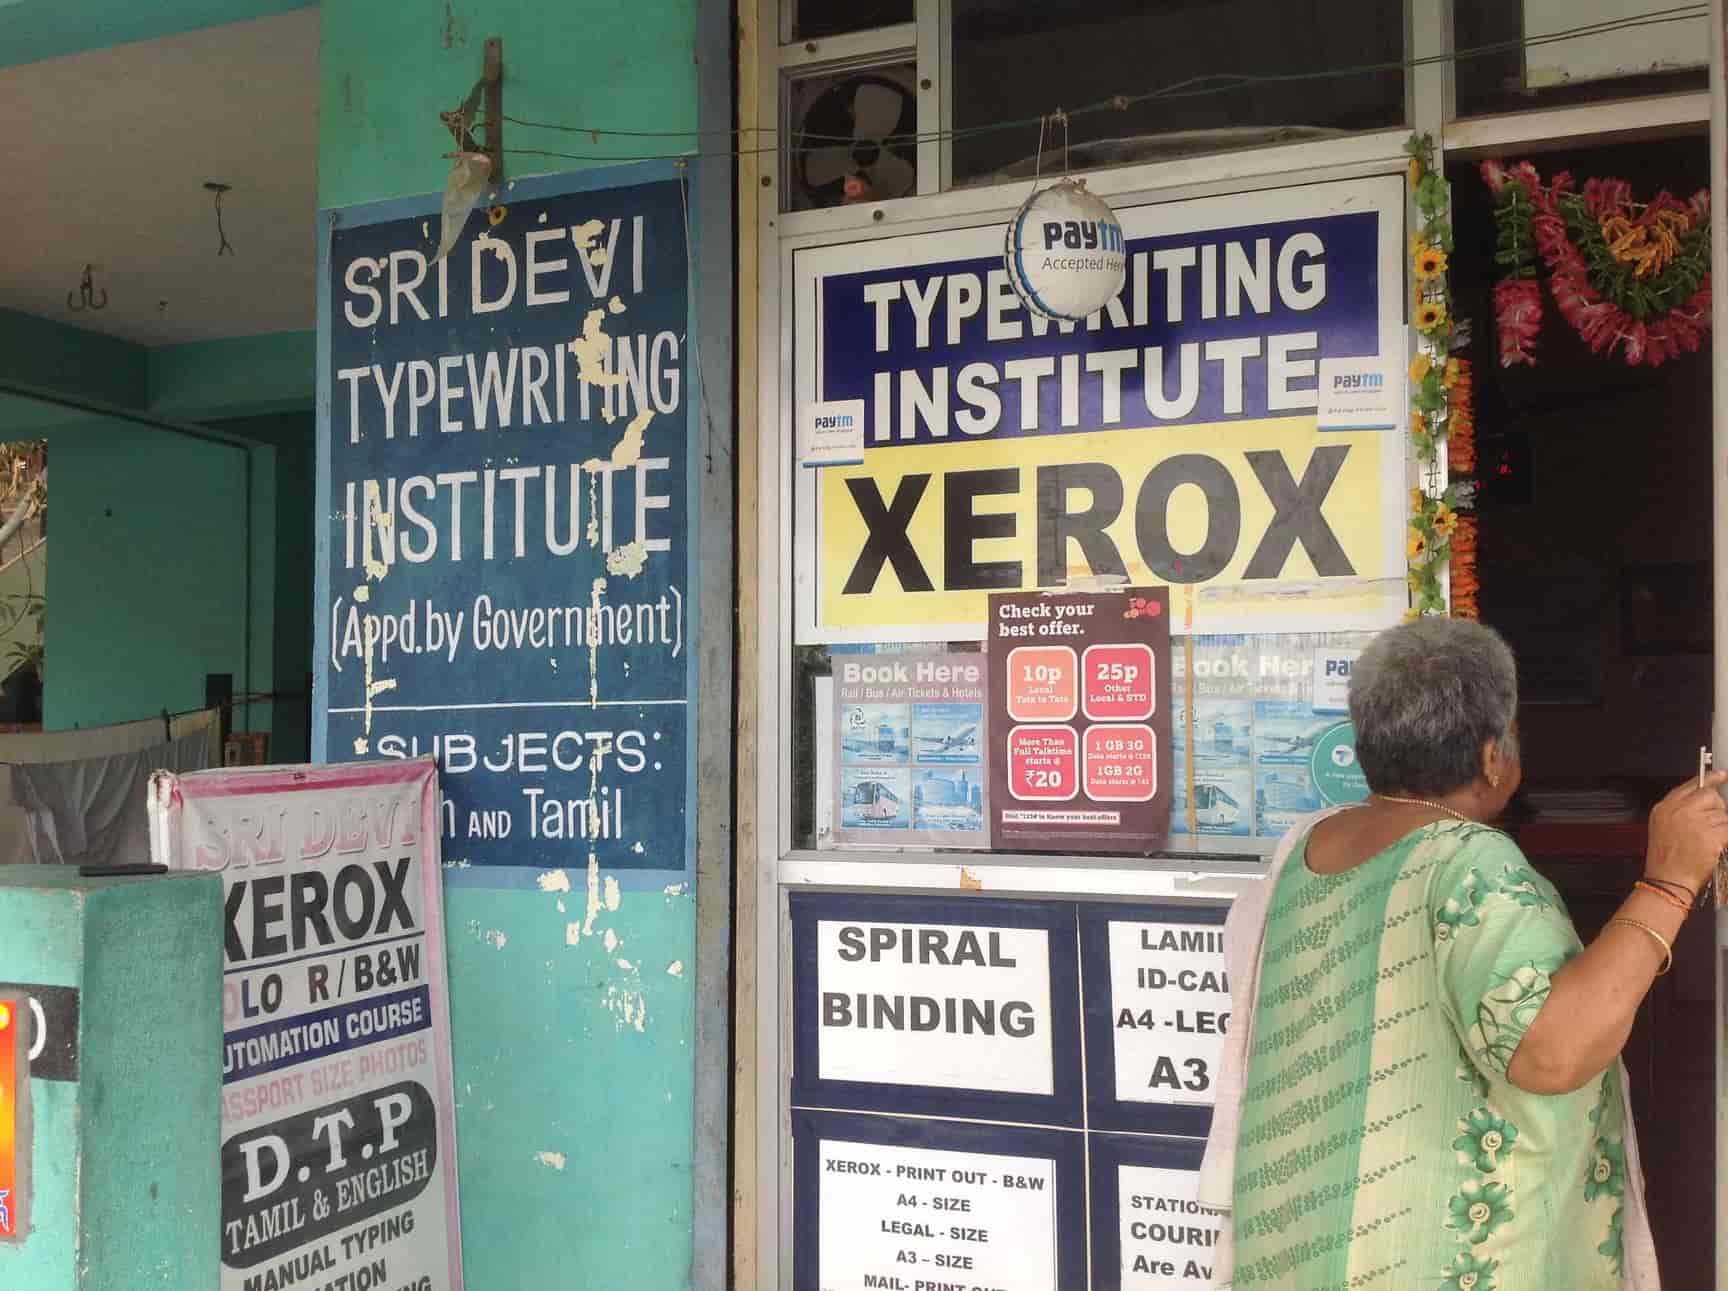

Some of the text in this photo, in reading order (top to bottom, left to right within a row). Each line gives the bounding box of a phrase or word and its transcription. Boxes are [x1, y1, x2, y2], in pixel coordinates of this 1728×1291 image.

[344, 215, 645, 328] SRI DEVI
[1041, 256, 1103, 273] Accepted
[863, 231, 1327, 353] TYPEITING
[337, 330, 681, 444] TYPEWRITING
[873, 331, 1319, 442] INSTITUTE
[344, 456, 672, 569] INSTITUTE
[841, 444, 1358, 595] XEROX
[471, 585, 683, 658] Government)
[999, 602, 1096, 620] Check your
[999, 620, 1085, 637] best offer.
[843, 661, 980, 683] Book Here
[1023, 665, 1063, 685] 10p
[1096, 664, 1139, 684] 25p
[908, 687, 940, 698] Tickets
[951, 687, 983, 699] Hotels
[1105, 739, 1125, 751] GB
[1024, 769, 1062, 789] ₹20
[467, 810, 513, 839] AND
[522, 786, 625, 840] Tamil
[837, 926, 1017, 969] SPIRAL
[1140, 928, 1224, 954] LAMI
[345, 997, 424, 1040] COURSE
[822, 991, 1035, 1039] BINDING
[1116, 1007, 1155, 1031] A4
[310, 1060, 355, 1097] SIZE
[358, 1039, 429, 1077] PHOTOS
[1147, 1055, 1211, 1092] A3
[239, 1092, 414, 1204] D.T.P
[825, 1158, 882, 1178] XEROX
[896, 1164, 947, 1183] PRINT
[951, 1167, 988, 1187] OUT
[1002, 1173, 1045, 1192] B&W
[225, 1147, 430, 1255] TAMIL & ENGLISH
[896, 1192, 918, 1209] A4
[932, 1195, 972, 1213] SIZE
[340, 1209, 415, 1261] TYPING
[881, 1219, 936, 1239] LEGAL
[949, 1225, 990, 1244] SIZE
[895, 1248, 918, 1265] A3
[934, 1253, 974, 1271] SIZE
[1132, 1254, 1176, 1277] Are
